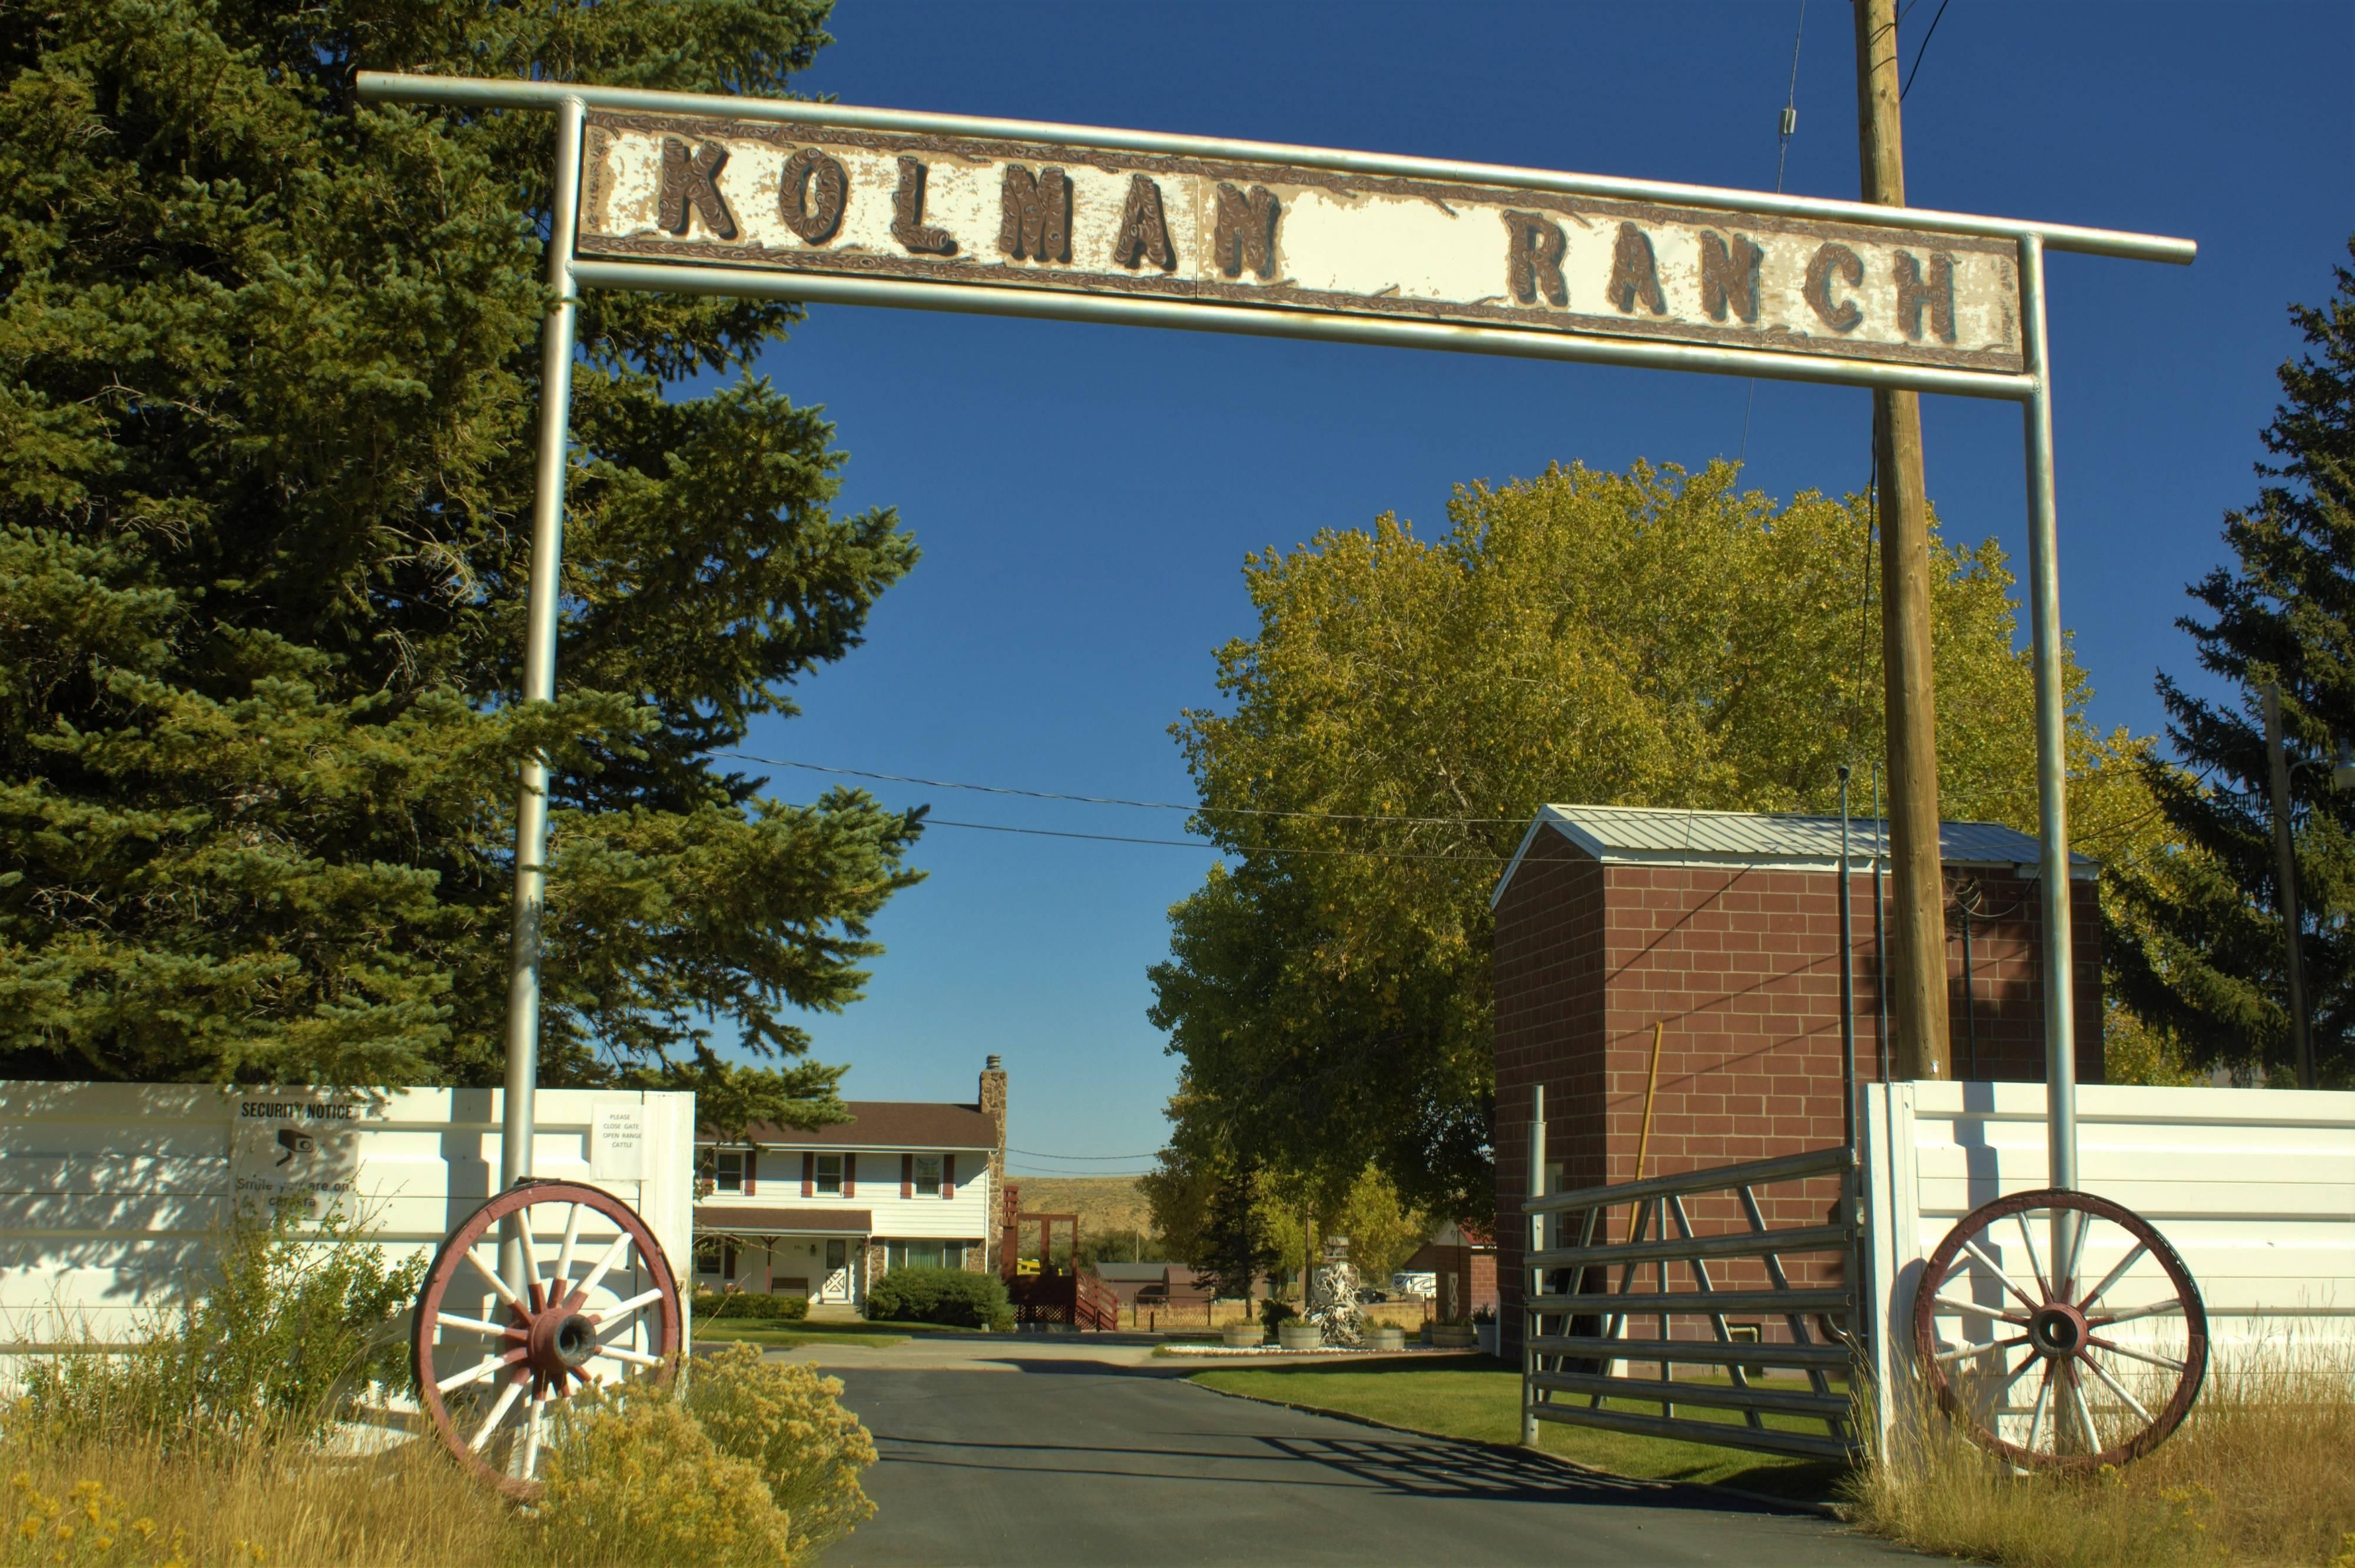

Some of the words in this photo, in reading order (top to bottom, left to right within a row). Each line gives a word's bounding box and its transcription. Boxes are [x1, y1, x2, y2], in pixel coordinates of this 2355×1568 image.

[657, 135, 1282, 279] KOLMAN
[1502, 208, 1957, 345] RANCH
[241, 1101, 303, 1118] SECURITY
[307, 1104, 353, 1119] NOTICE
[237, 1178, 273, 1191] Smile
[309, 1181, 328, 1191] are
[333, 1182, 350, 1191] on
